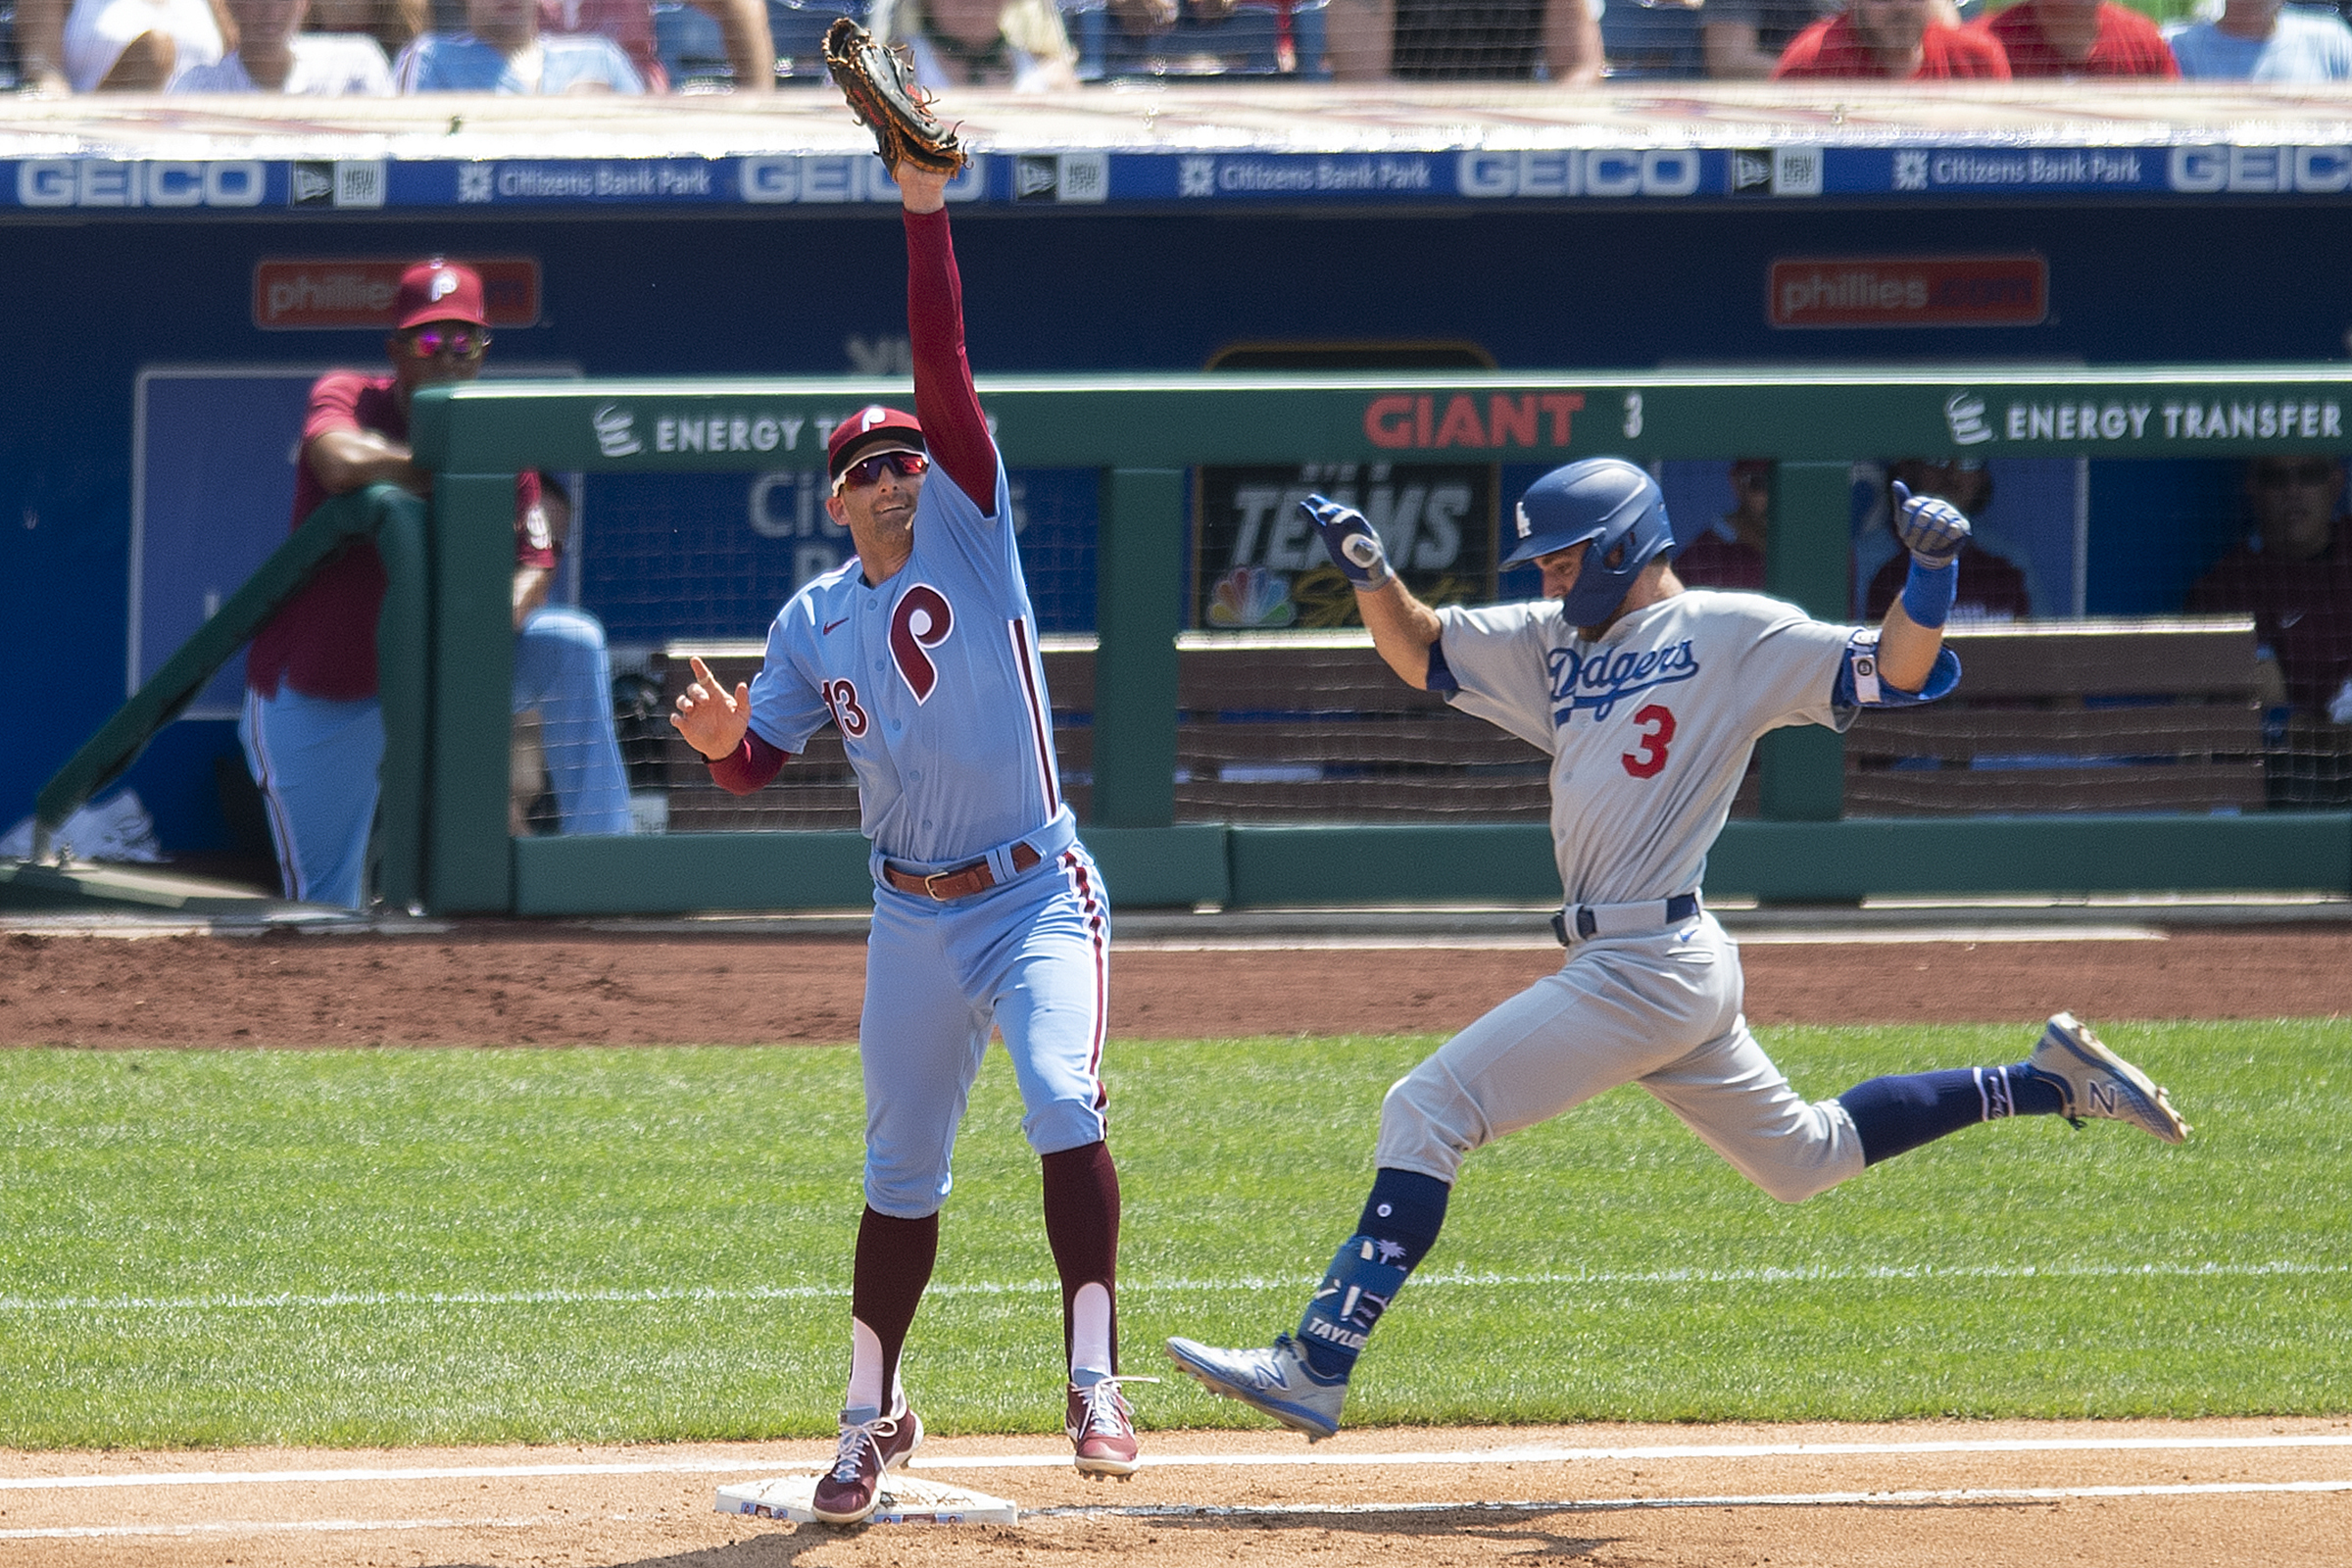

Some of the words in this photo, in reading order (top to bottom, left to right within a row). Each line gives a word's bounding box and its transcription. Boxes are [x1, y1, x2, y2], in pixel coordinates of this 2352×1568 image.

[18, 159, 266, 207] GEICO
[498, 165, 593, 196] Citizens
[594, 163, 656, 196] Bank
[658, 163, 711, 195] Park
[1219, 160, 1315, 191] Citizens
[1316, 158, 1376, 190] Bank
[1378, 158, 1431, 190] Park
[1457, 148, 1701, 196] GEICO
[1933, 152, 2026, 184] Citizens
[2028, 151, 2087, 183] Bank
[2089, 150, 2140, 182] Park
[431, 270, 458, 303] P
[655, 416, 808, 454] ENERGY
[861, 408, 886, 432] P
[1363, 392, 1586, 449] GIANT
[2005, 403, 2152, 442] ENERGY
[2162, 402, 2343, 440] TRANSFER
[888, 582, 955, 707] P
[1547, 639, 1699, 723] Ddgers
[821, 677, 869, 741] 13
[1621, 704, 1677, 779] 3
